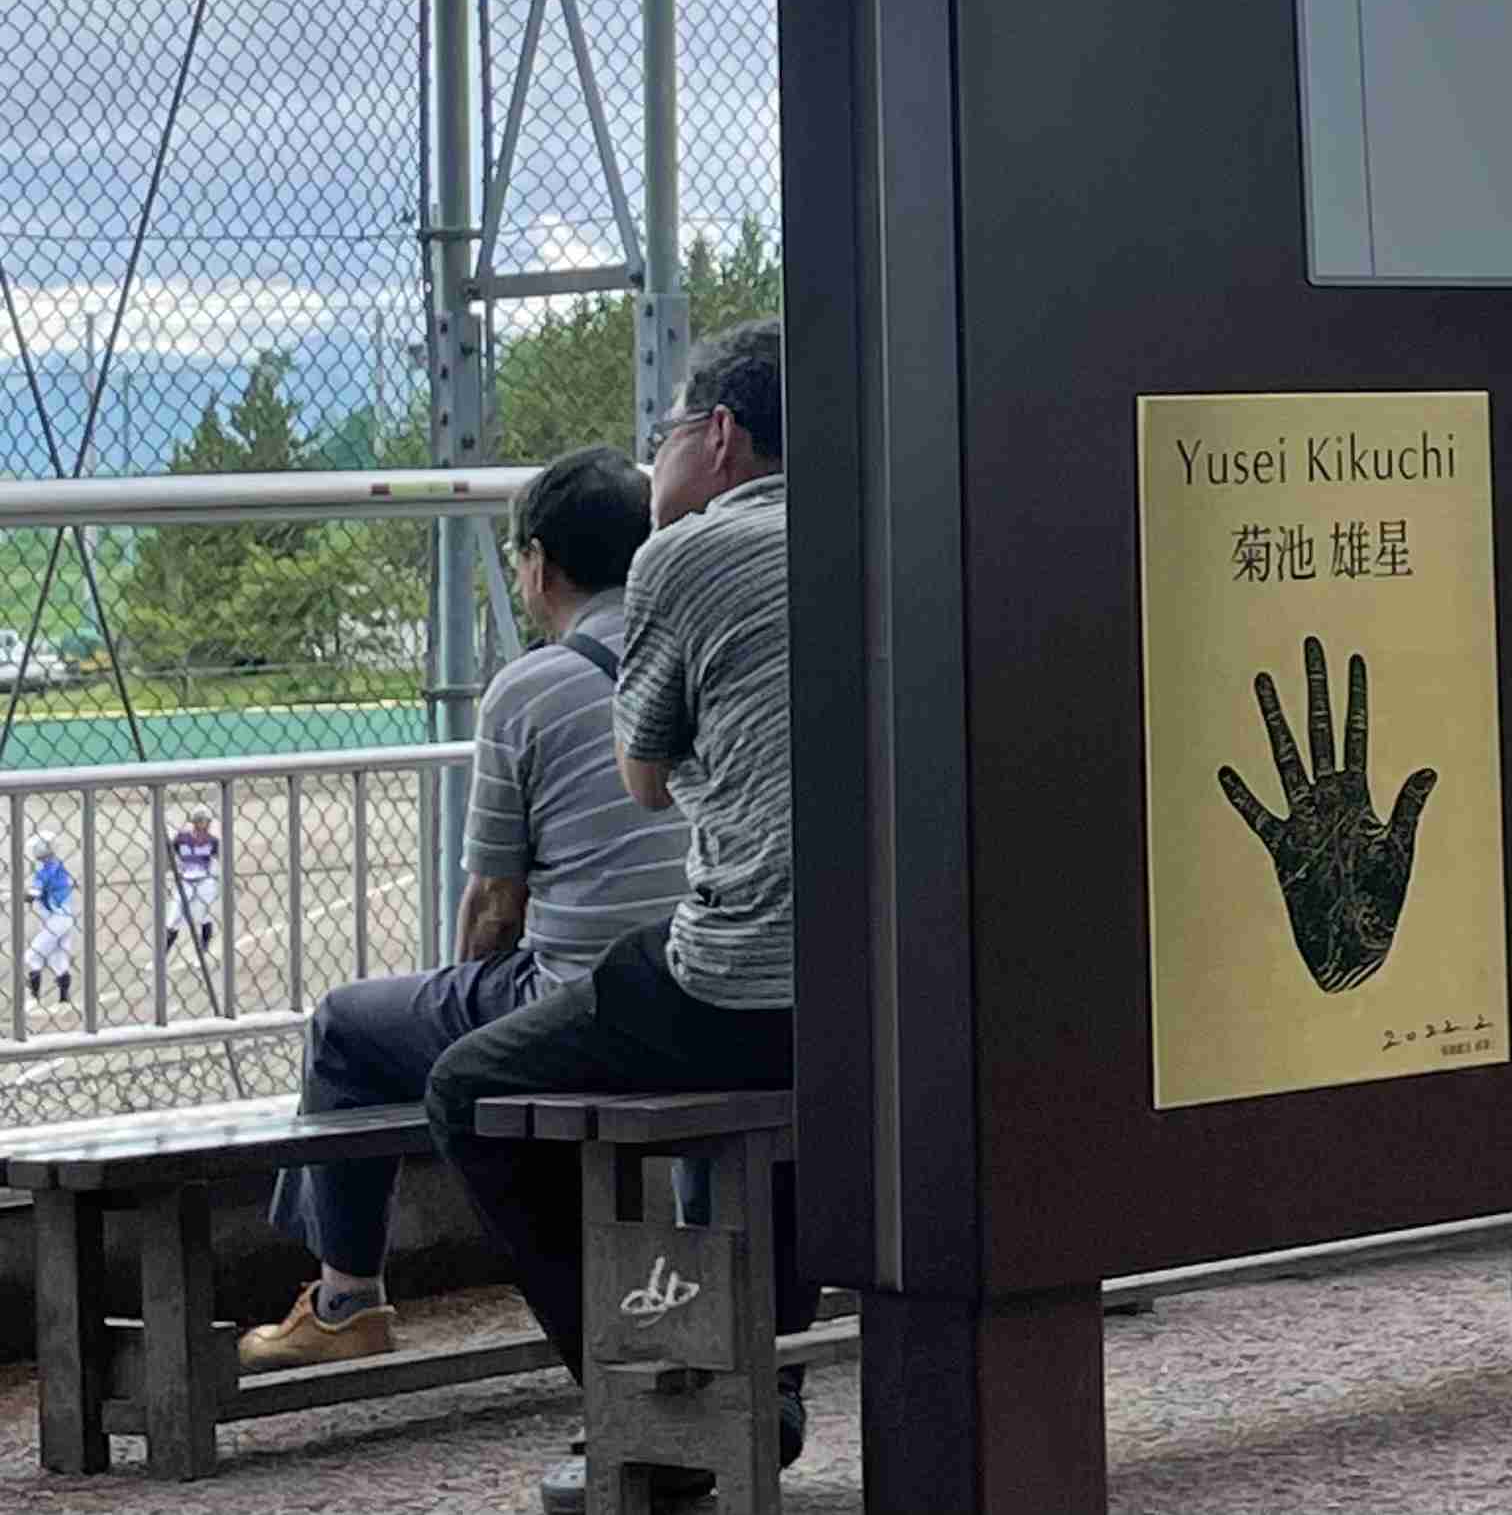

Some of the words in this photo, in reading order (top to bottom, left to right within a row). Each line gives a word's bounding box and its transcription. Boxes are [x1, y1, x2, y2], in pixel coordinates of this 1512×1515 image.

[1176, 437, 1288, 485] Yusei
[1306, 431, 1456, 482] Kikuchi
[1232, 523, 1316, 583] 菊池
[1329, 519, 1414, 579] 雄星
